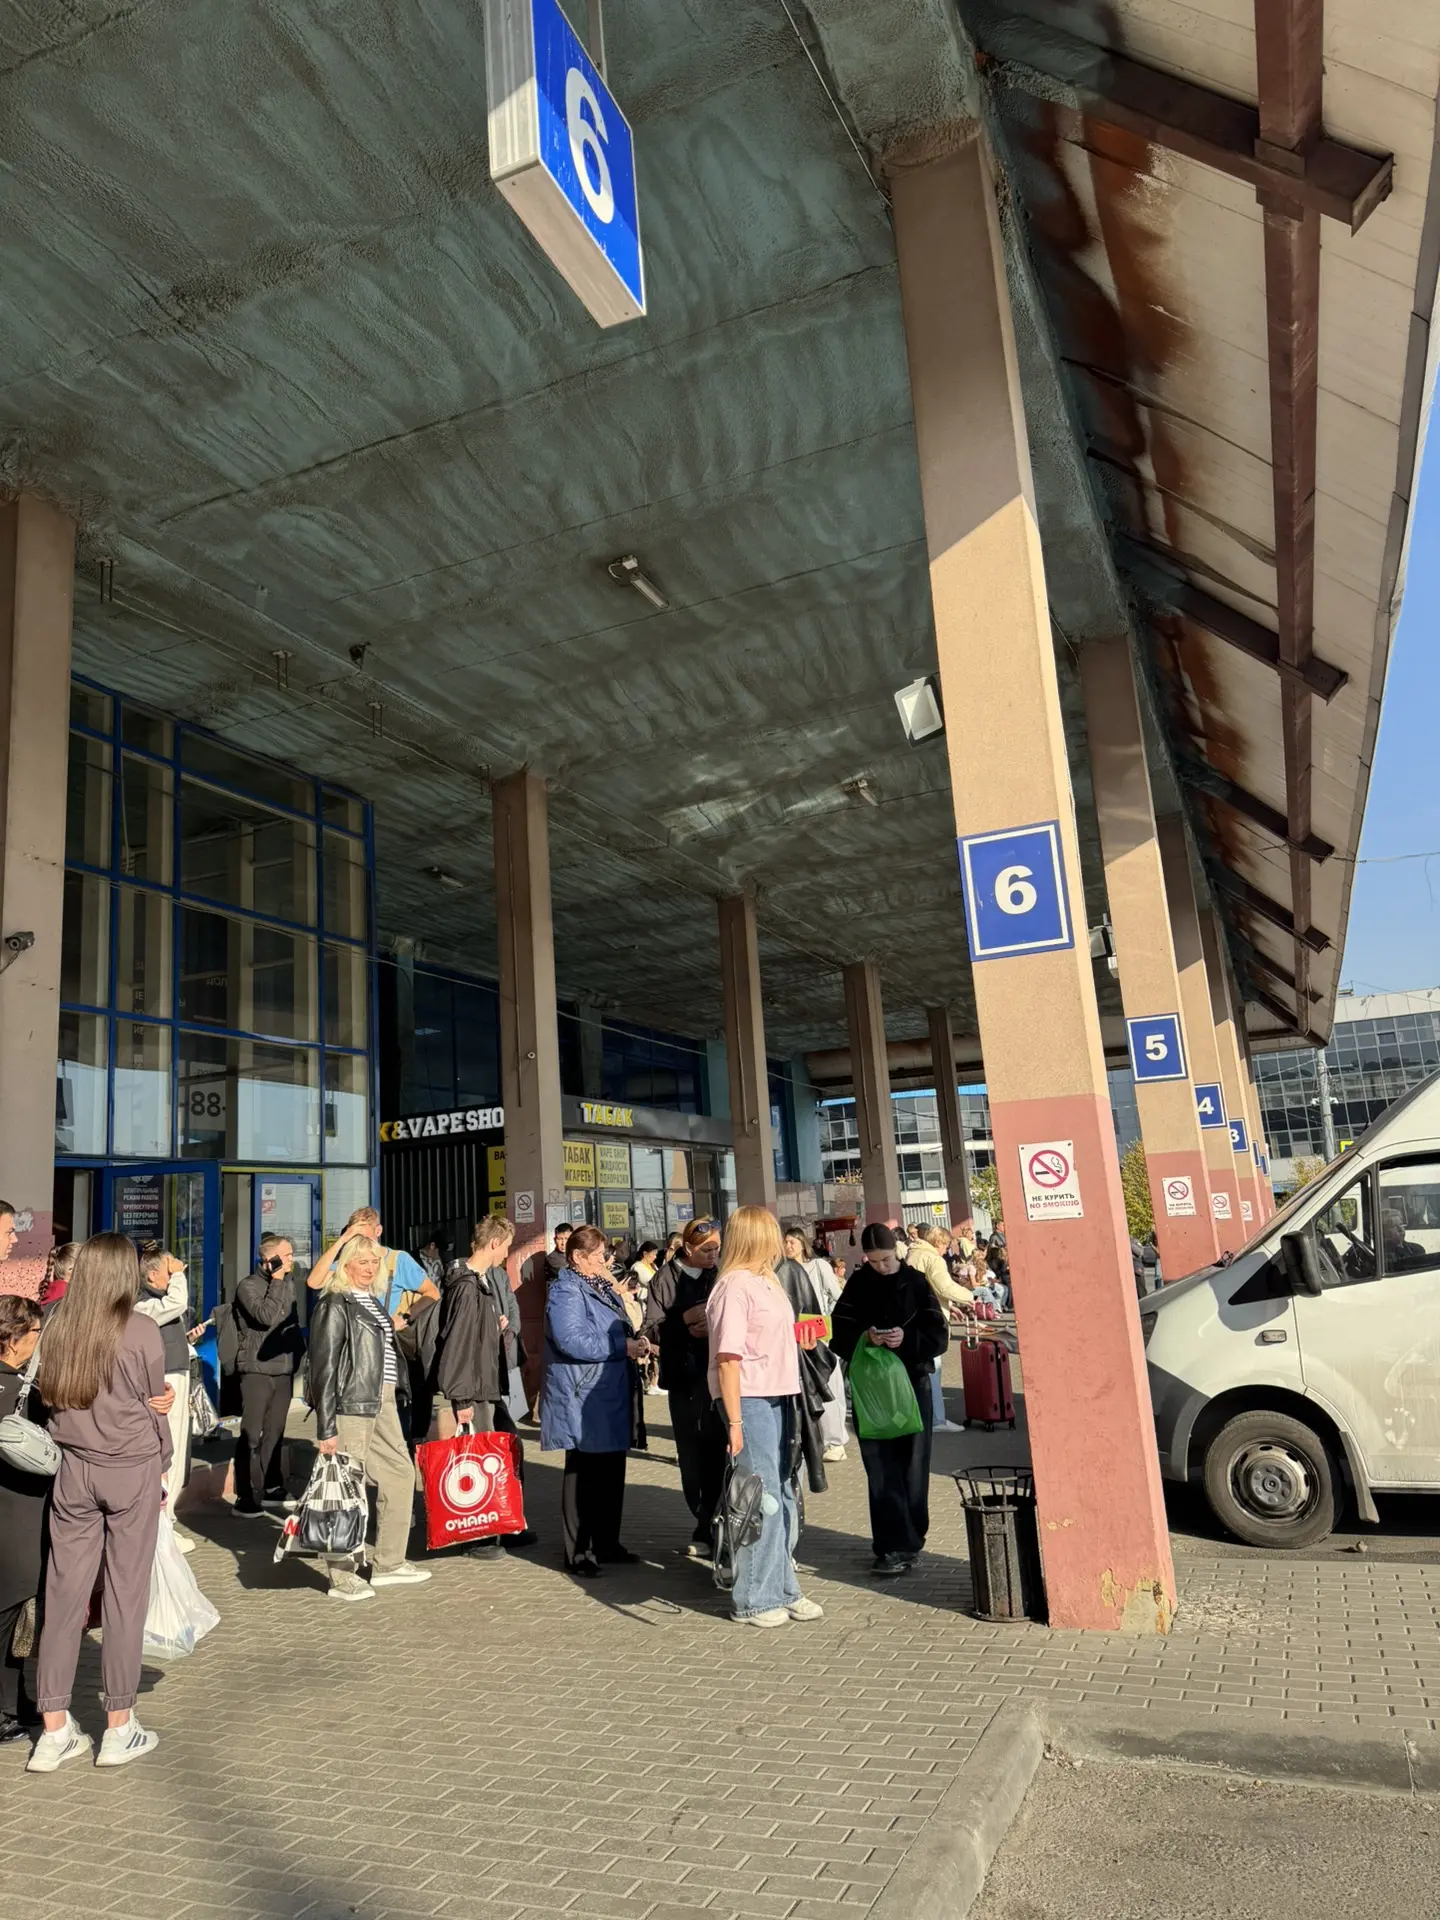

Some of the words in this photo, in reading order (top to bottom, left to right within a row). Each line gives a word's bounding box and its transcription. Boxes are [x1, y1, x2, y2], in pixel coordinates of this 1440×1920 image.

[566, 67, 614, 224] 6
[994, 865, 1037, 915] 6
[1145, 1033, 1168, 1061] 5
[581, 1103, 633, 1127] ТАБАК
[1198, 1097, 1214, 1115] 4
[1230, 1128, 1240, 1143] 3
[563, 1146, 591, 1164] ТАБАК
[1043, 1200, 1080, 1208] SMOKING
[1044, 1193, 1075, 1201] КУРИТЬ
[445, 1511, 499, 1531] O'HARA
